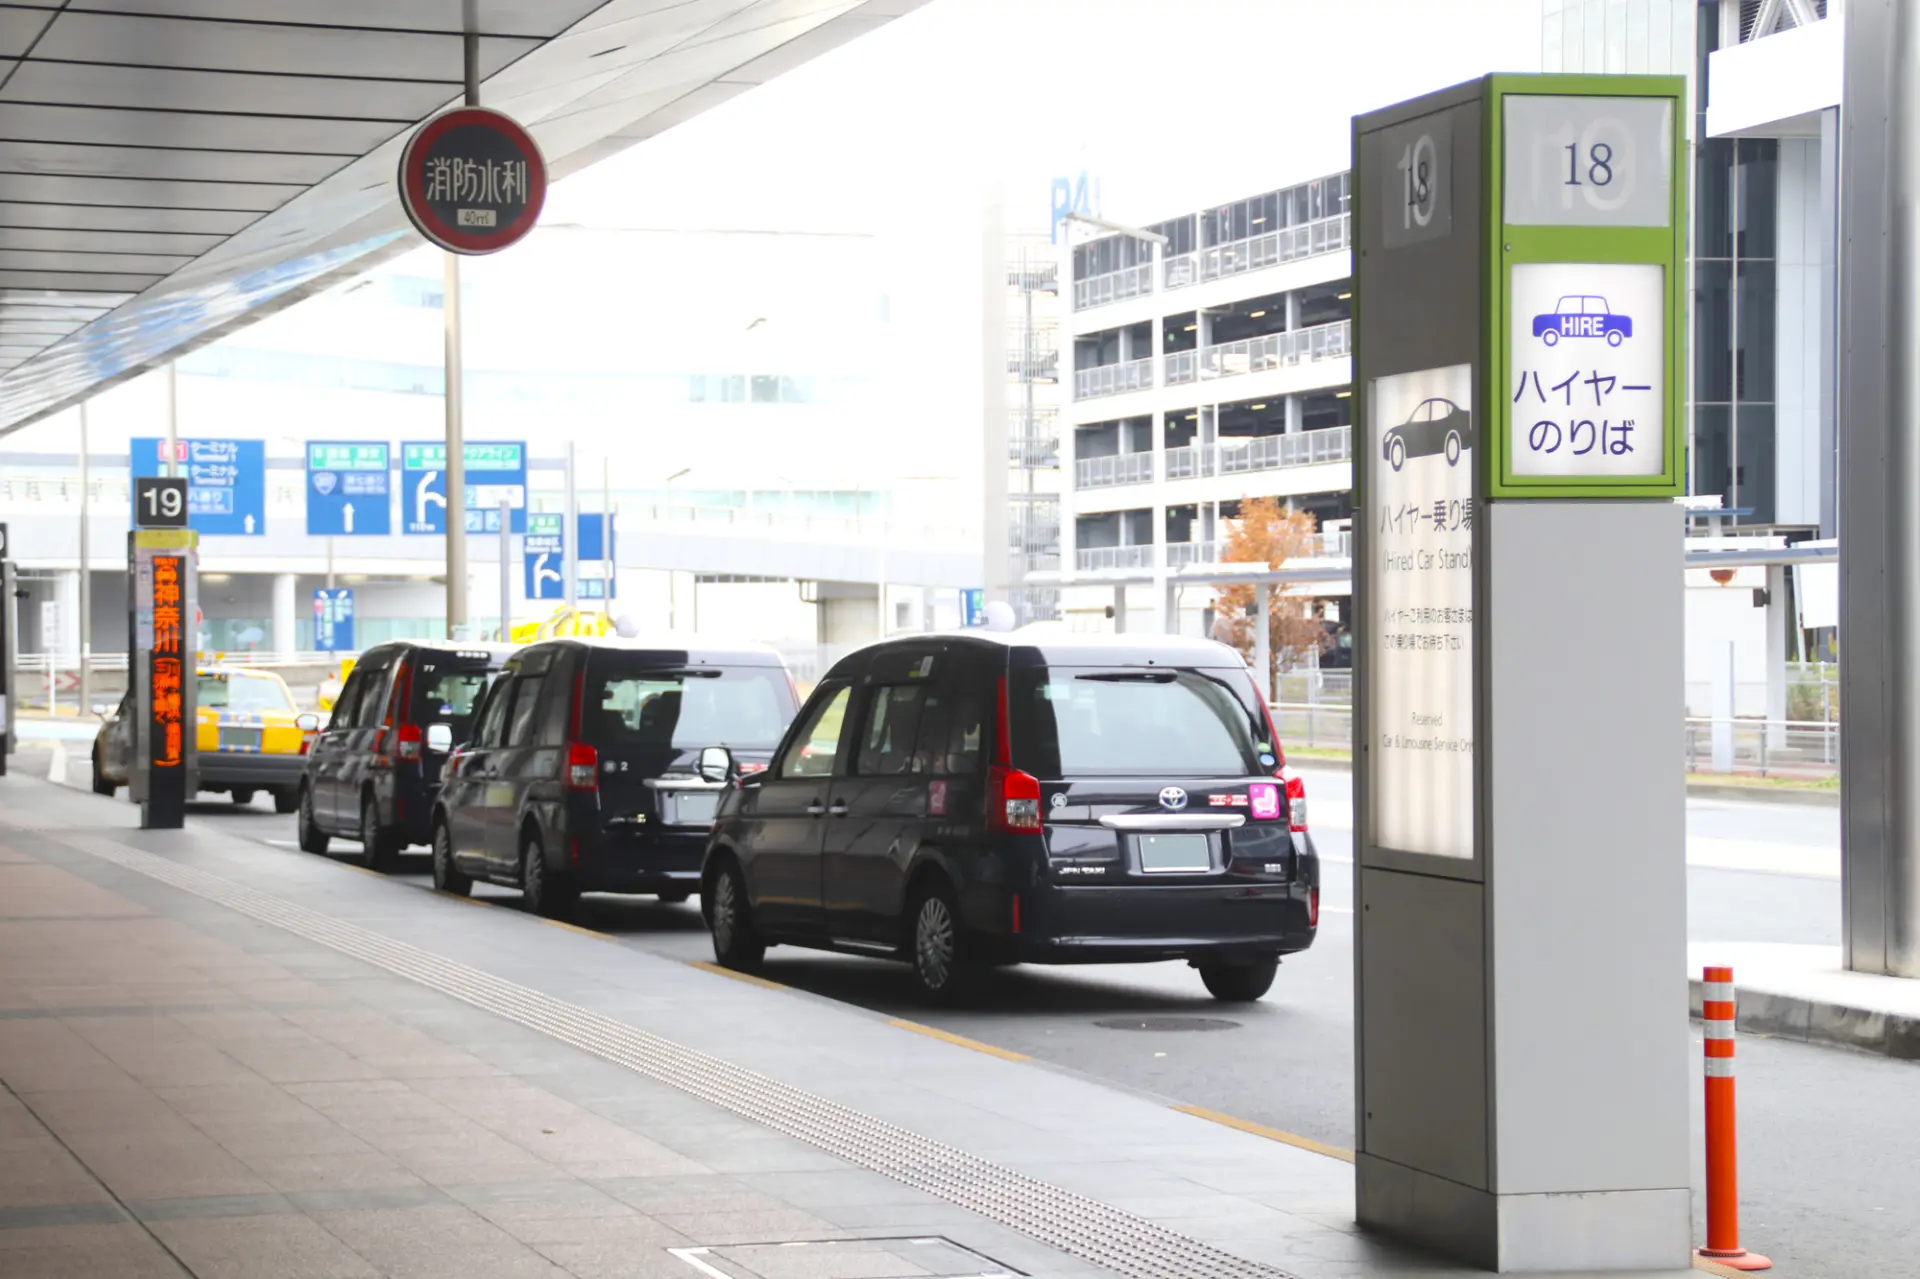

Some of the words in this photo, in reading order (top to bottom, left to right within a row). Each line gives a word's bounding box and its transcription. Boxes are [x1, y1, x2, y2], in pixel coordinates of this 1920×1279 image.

[426, 157, 527, 205] 消防水利
[1564, 142, 1613, 186] 18
[1561, 316, 1604, 336] HIRE
[1513, 369, 1652, 407] ハイヤー
[1529, 419, 1635, 455] のりば
[142, 487, 182, 517] 19
[1381, 498, 1472, 534] ハイヤー乗り場
[1383, 549, 1413, 573] (Hired
[1418, 549, 1434, 570] Car
[1439, 546, 1472, 571] Stand)
[153, 584, 180, 654] 神奈川
[1411, 711, 1443, 727] Reserved
